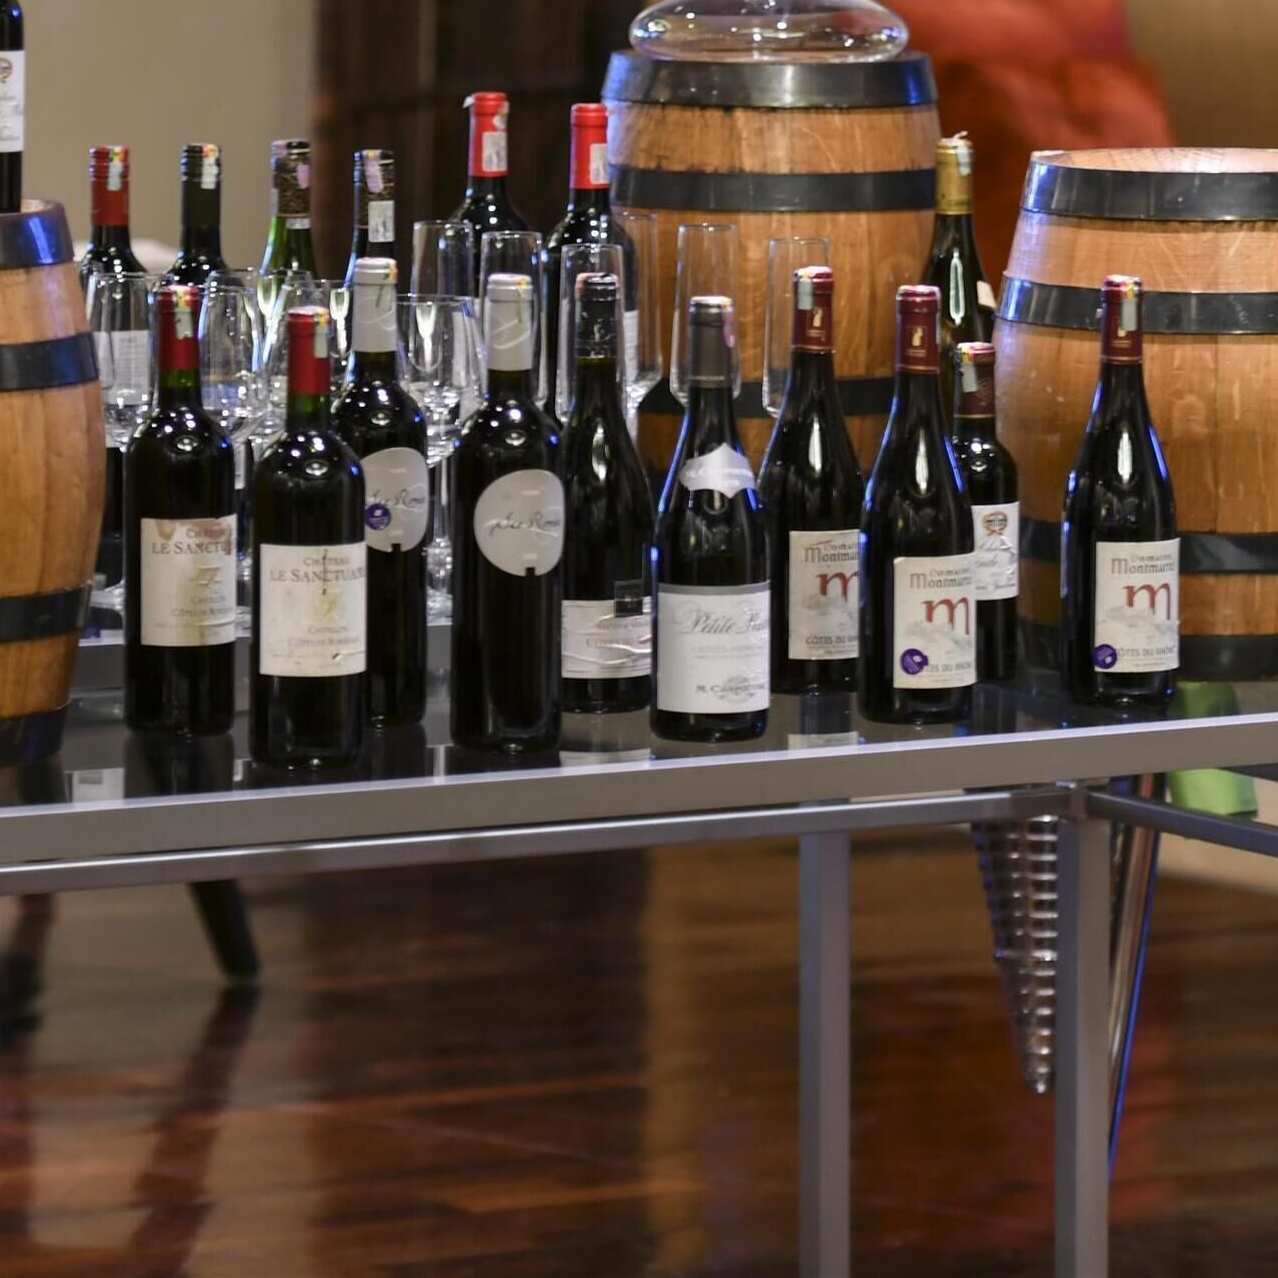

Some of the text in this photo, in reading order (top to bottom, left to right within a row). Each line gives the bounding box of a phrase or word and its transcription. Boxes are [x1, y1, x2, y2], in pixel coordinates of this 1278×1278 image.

[151, 542, 170, 555] LE
[269, 569, 286, 582] LE
[1121, 582, 1171, 620] m
[920, 596, 970, 636] m
